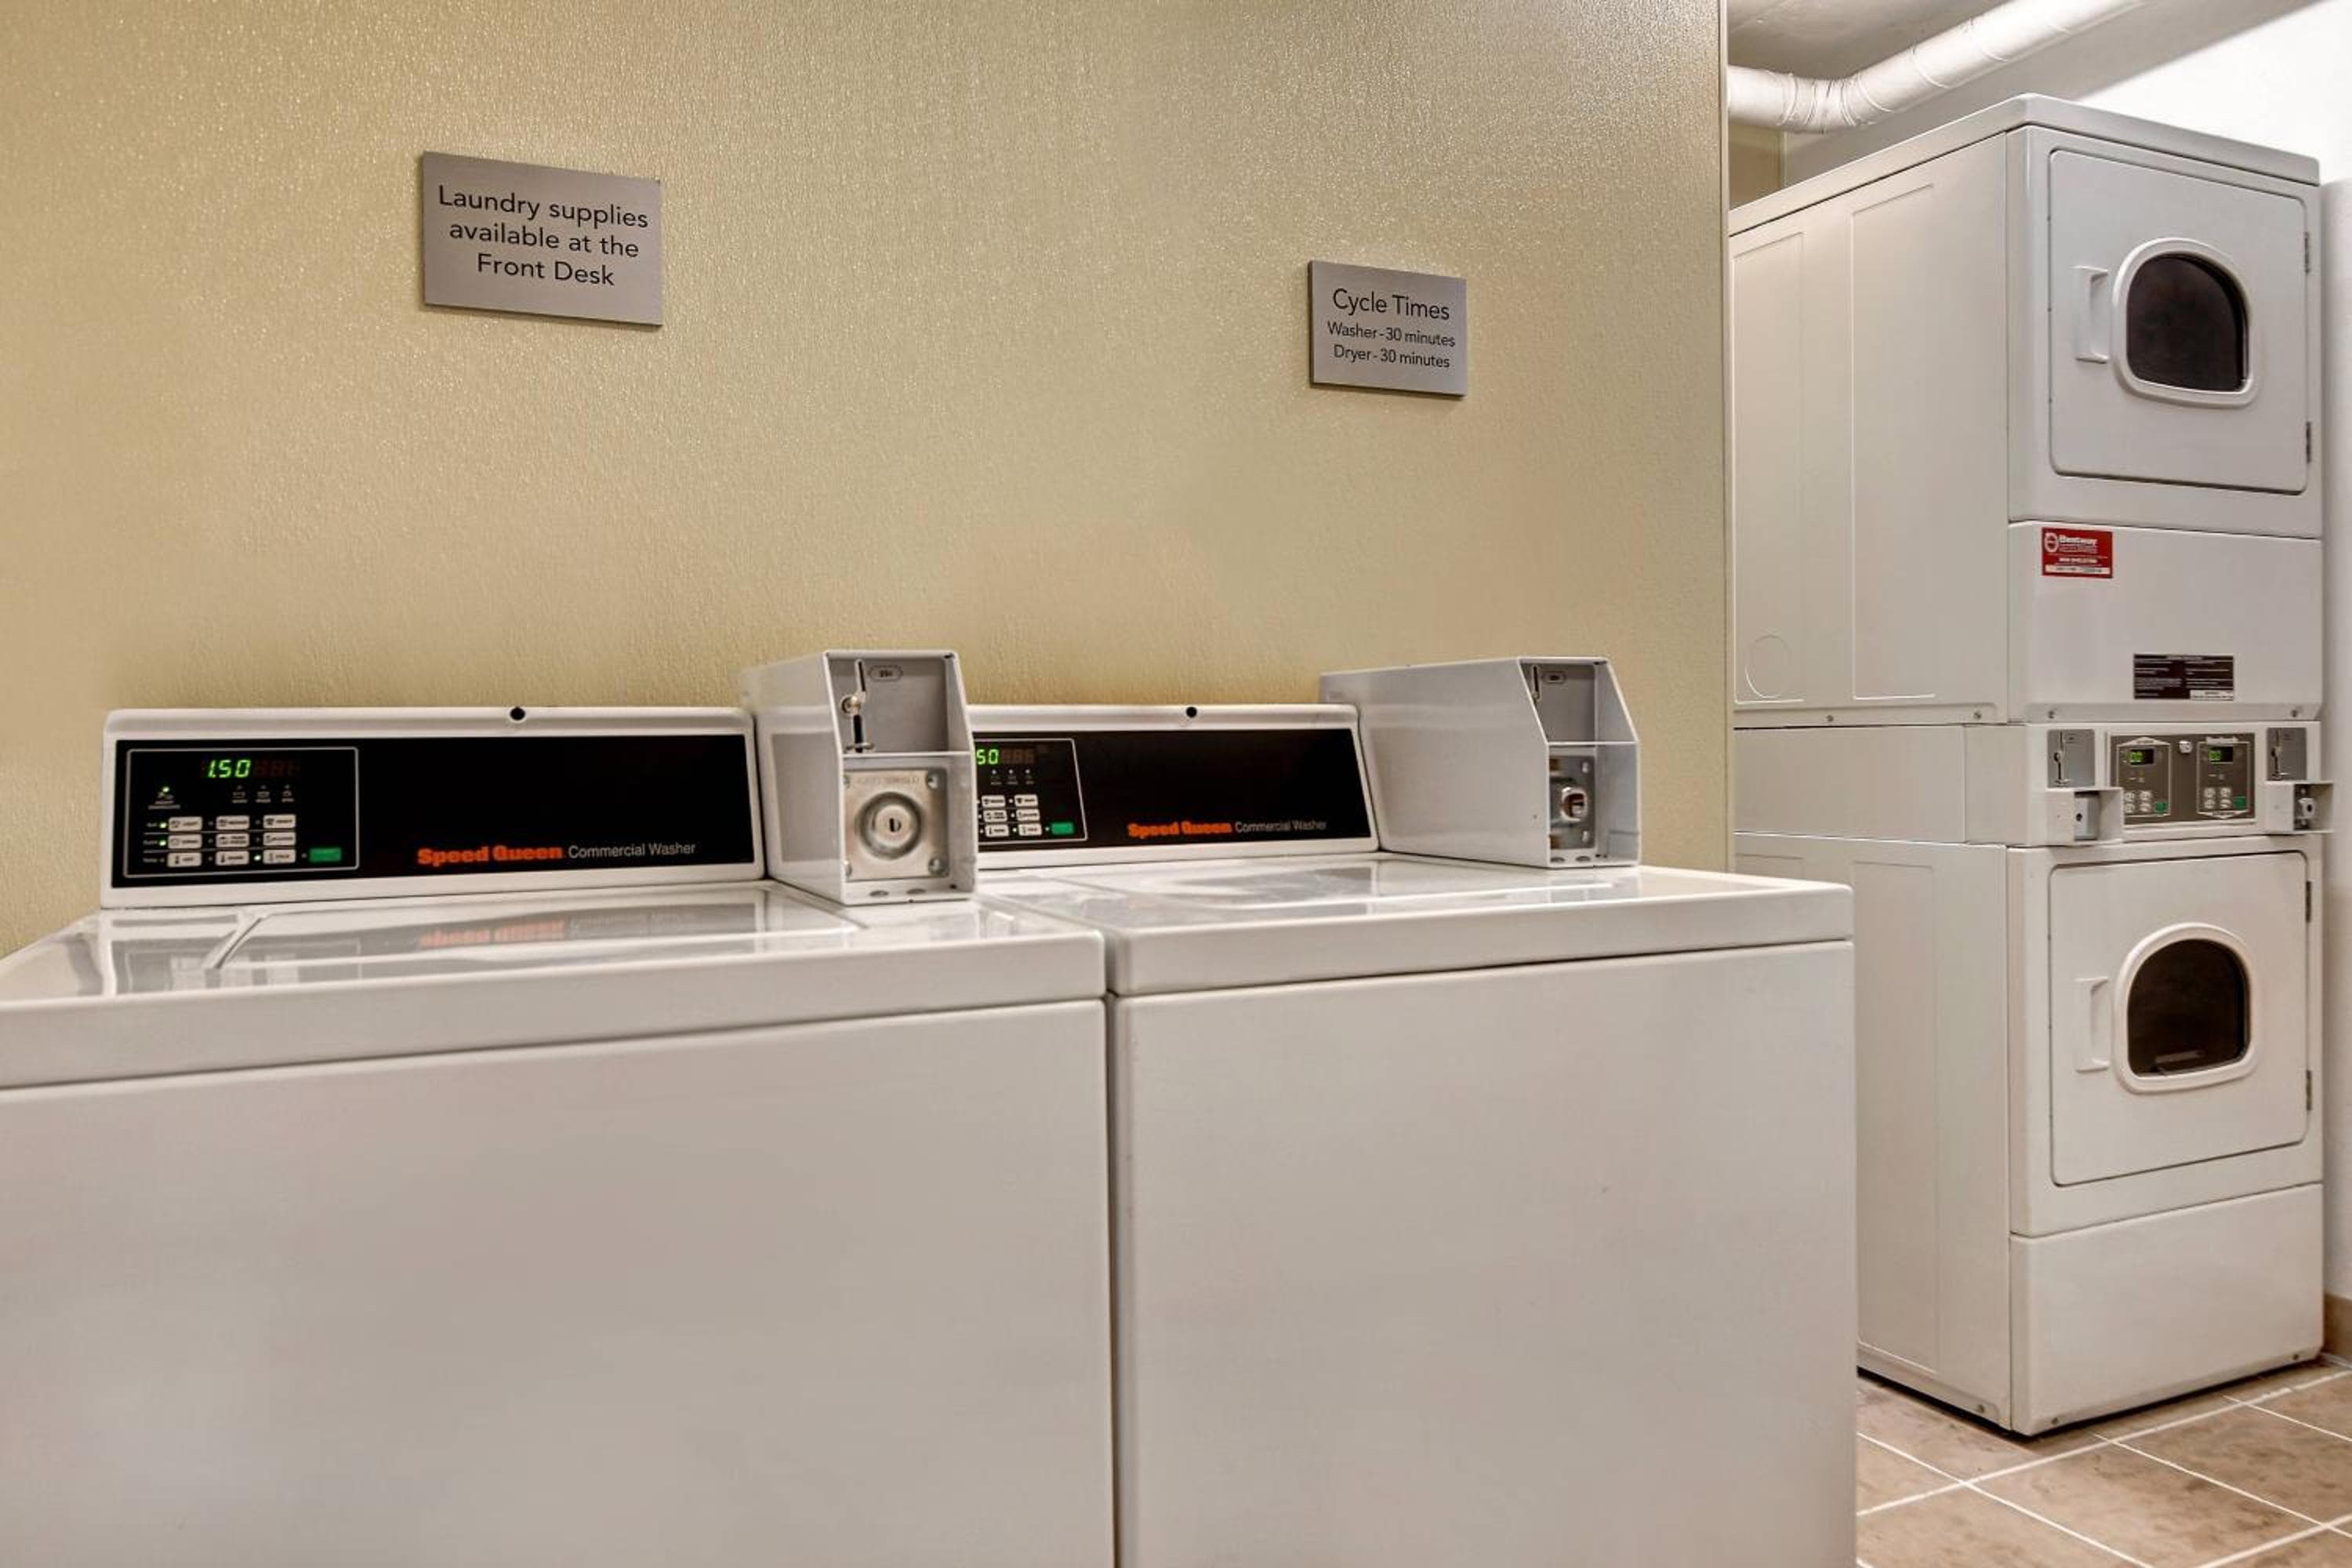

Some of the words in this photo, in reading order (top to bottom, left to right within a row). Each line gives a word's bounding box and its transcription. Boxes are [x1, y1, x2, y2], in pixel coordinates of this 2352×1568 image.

[439, 185, 539, 220] Laundry
[550, 204, 648, 228] supplies
[450, 223, 559, 249] available
[569, 236, 591, 252] at
[600, 235, 638, 257] the
[477, 252, 544, 278] Front
[555, 261, 614, 285] Desk
[1333, 289, 1387, 316] Cycle
[1392, 295, 1450, 320] Times
[1405, 330, 1456, 347] minutes
[1399, 352, 1450, 368] minutes
[208, 759, 251, 778] 1.50
[1128, 822, 1180, 839] Speed
[1181, 821, 1232, 835] Queen
[1235, 821, 1291, 833] Commercial
[1292, 819, 1327, 832] Washer
[418, 846, 489, 866] Speed
[492, 845, 563, 861] Queen
[568, 844, 645, 858] Commercial
[649, 842, 696, 856] Washer
